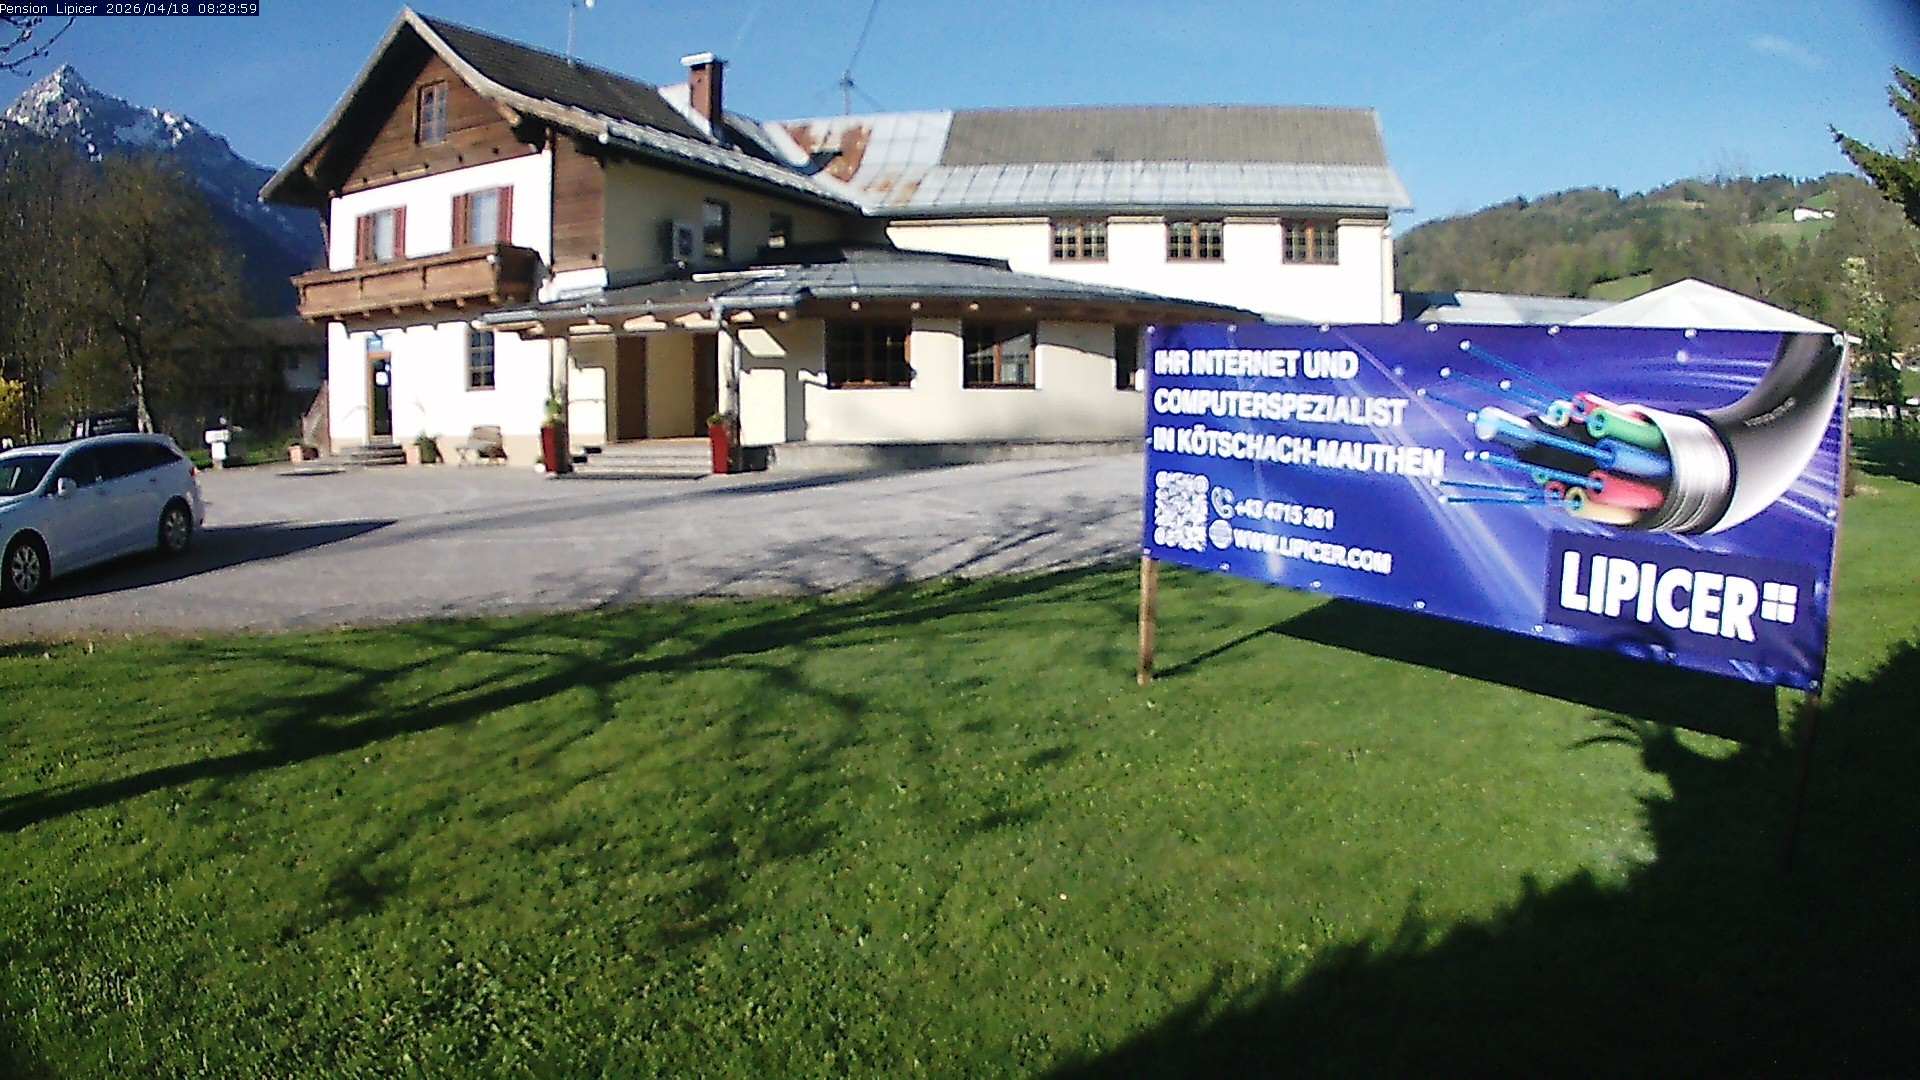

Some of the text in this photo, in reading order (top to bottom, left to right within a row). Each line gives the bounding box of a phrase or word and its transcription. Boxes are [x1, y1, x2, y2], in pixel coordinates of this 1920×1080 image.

[1154, 349, 1359, 379] IHR INTERNET UND
[1154, 388, 1408, 427] COMPUTERSPEZIALIST
[1153, 424, 1445, 477] IN KÖTSCHACH-MAUTHEN
[1234, 499, 1264, 519] +43
[1560, 550, 1758, 643] LIPICER
